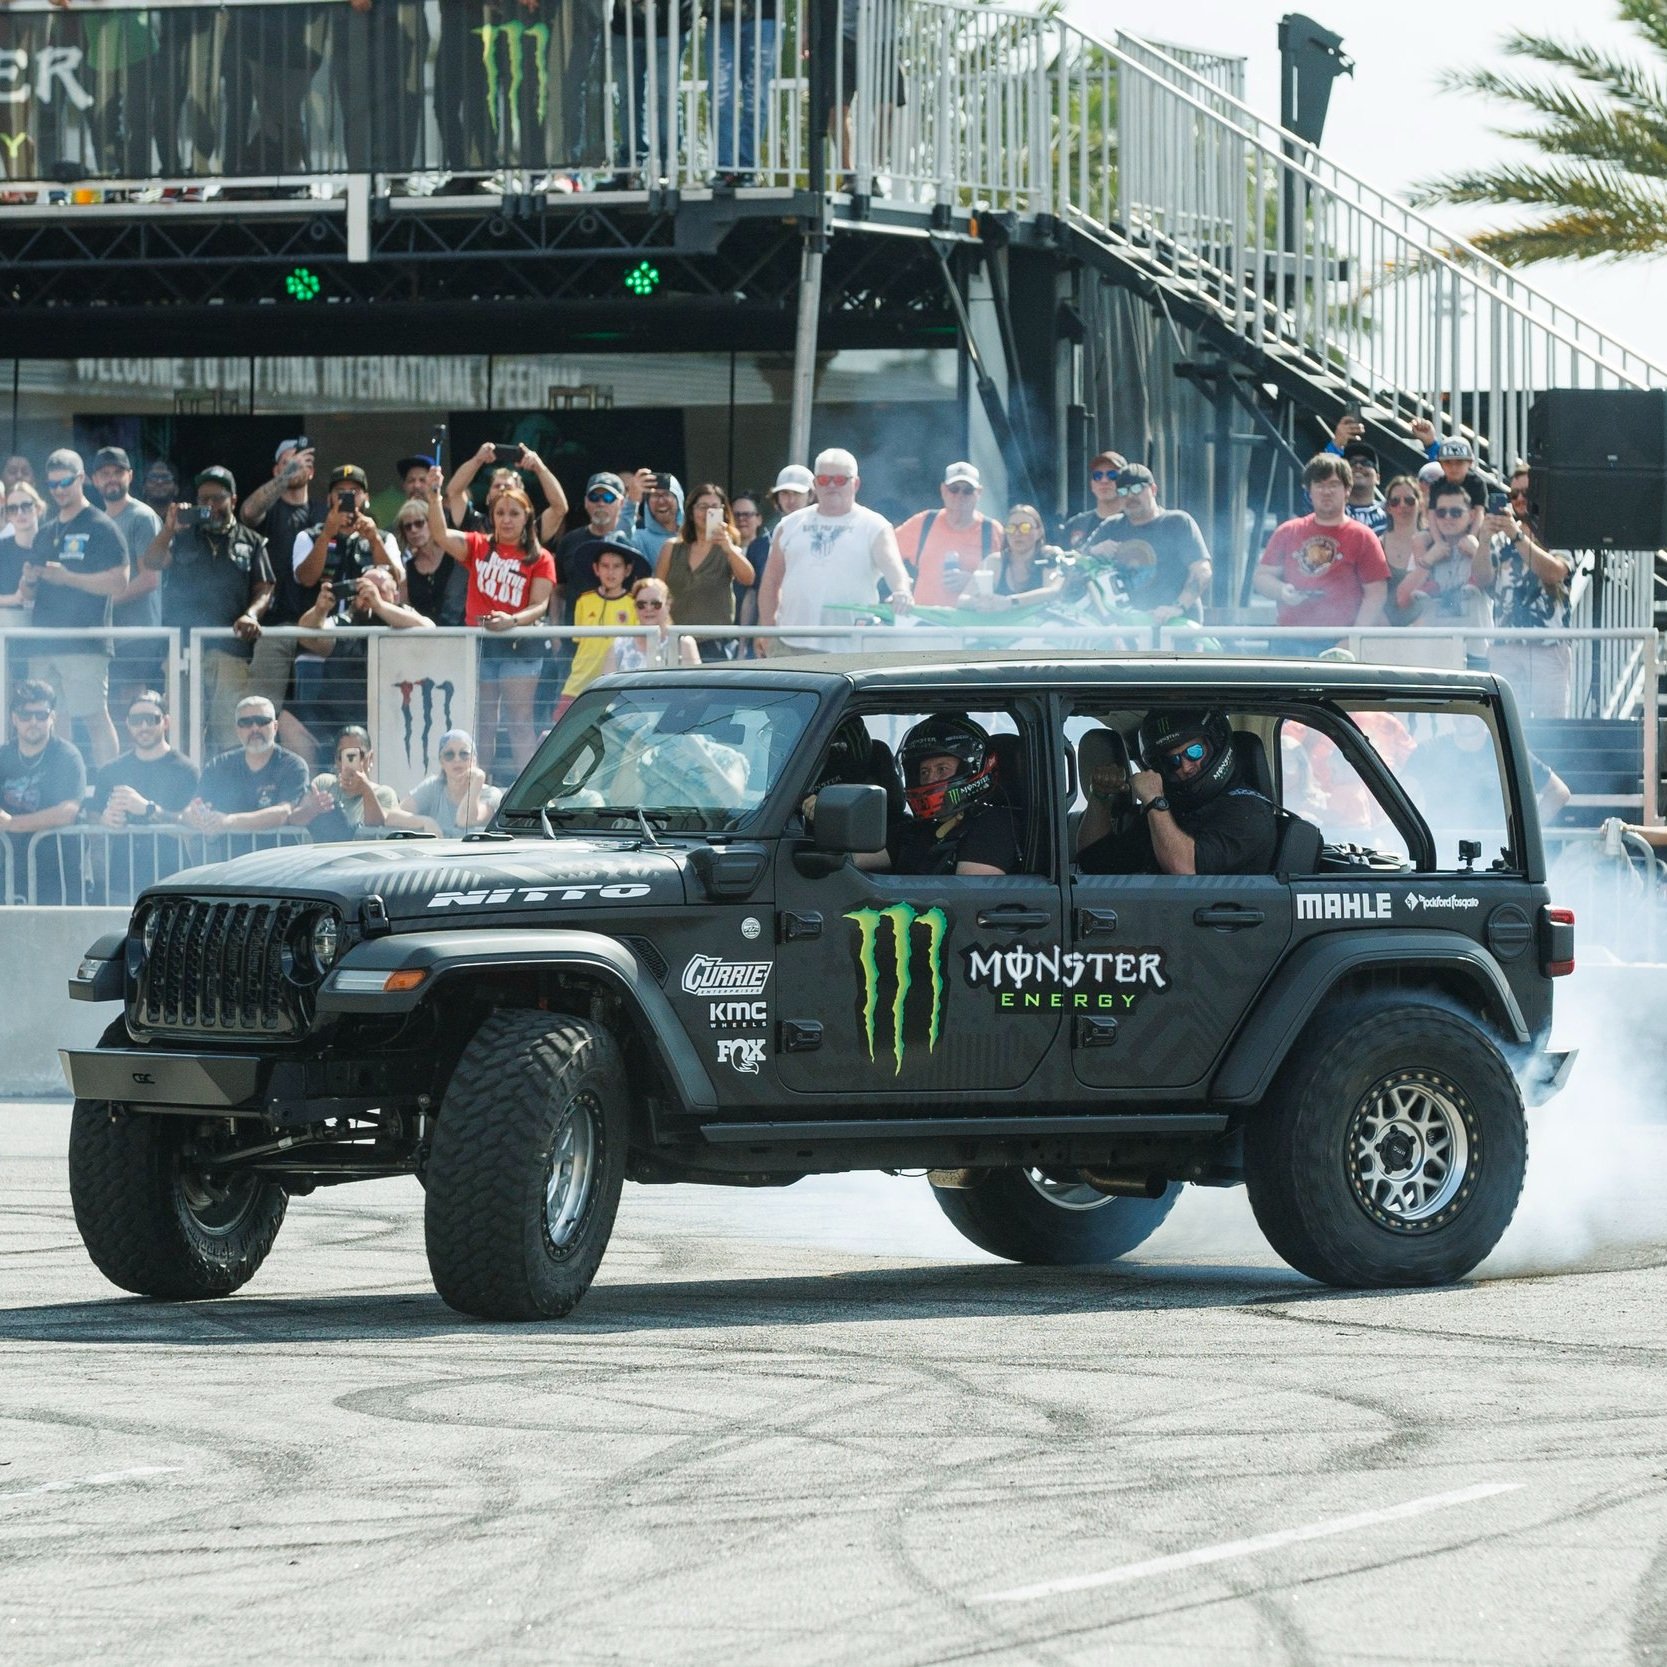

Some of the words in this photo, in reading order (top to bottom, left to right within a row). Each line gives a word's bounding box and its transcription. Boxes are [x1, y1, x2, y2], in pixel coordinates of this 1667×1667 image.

[427, 884, 651, 907] NITTO
[1296, 893, 1392, 920] MAHLE
[685, 957, 768, 991] CURRIE
[969, 945, 1166, 989] MONSTER
[710, 1001, 767, 1021] KMC
[1001, 993, 1136, 1008] ENERGY
[717, 1038, 767, 1073] FOX
